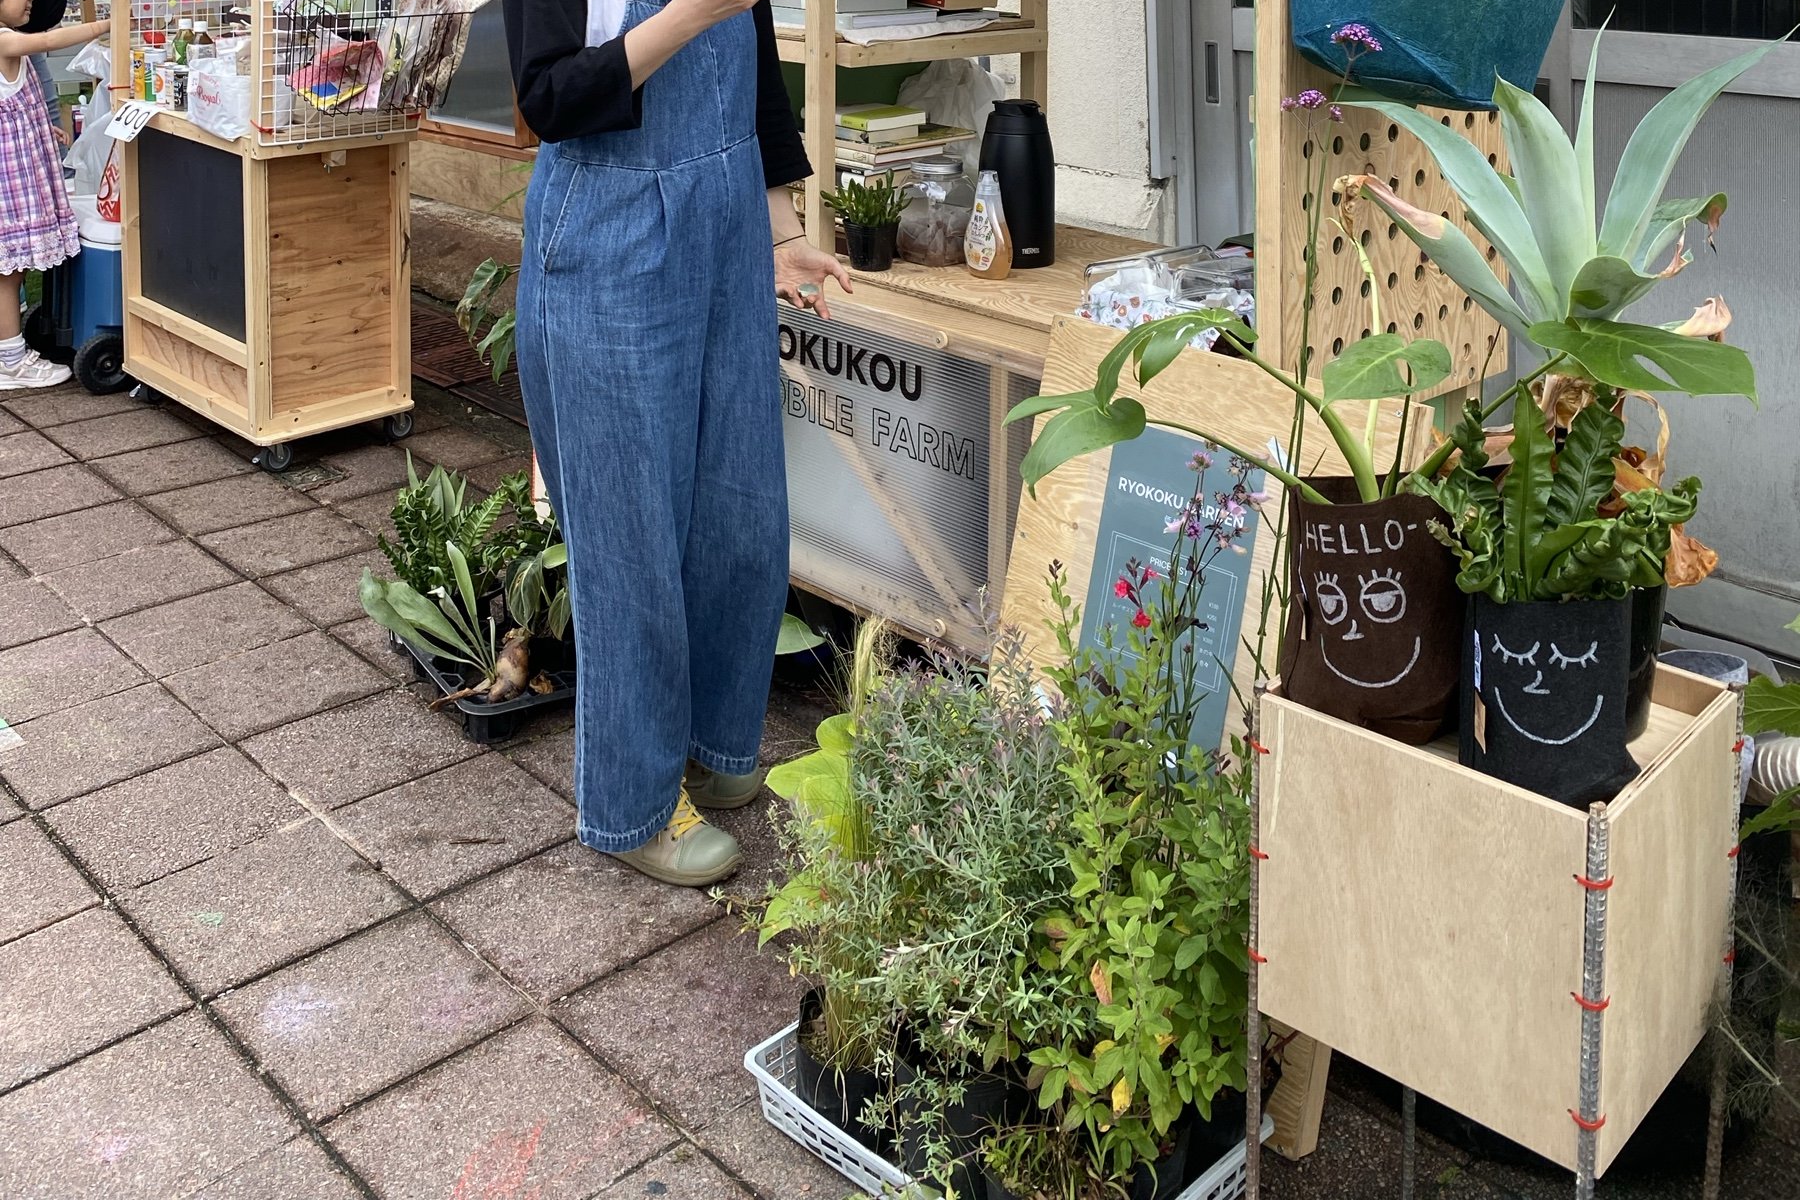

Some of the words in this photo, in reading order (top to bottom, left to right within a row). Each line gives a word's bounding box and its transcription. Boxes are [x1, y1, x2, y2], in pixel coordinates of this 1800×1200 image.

[115, 105, 151, 130] 100
[872, 407, 975, 480] FARM
[1118, 476, 1184, 510] RYOKOKU
[1149, 556, 1172, 571] PRICE
